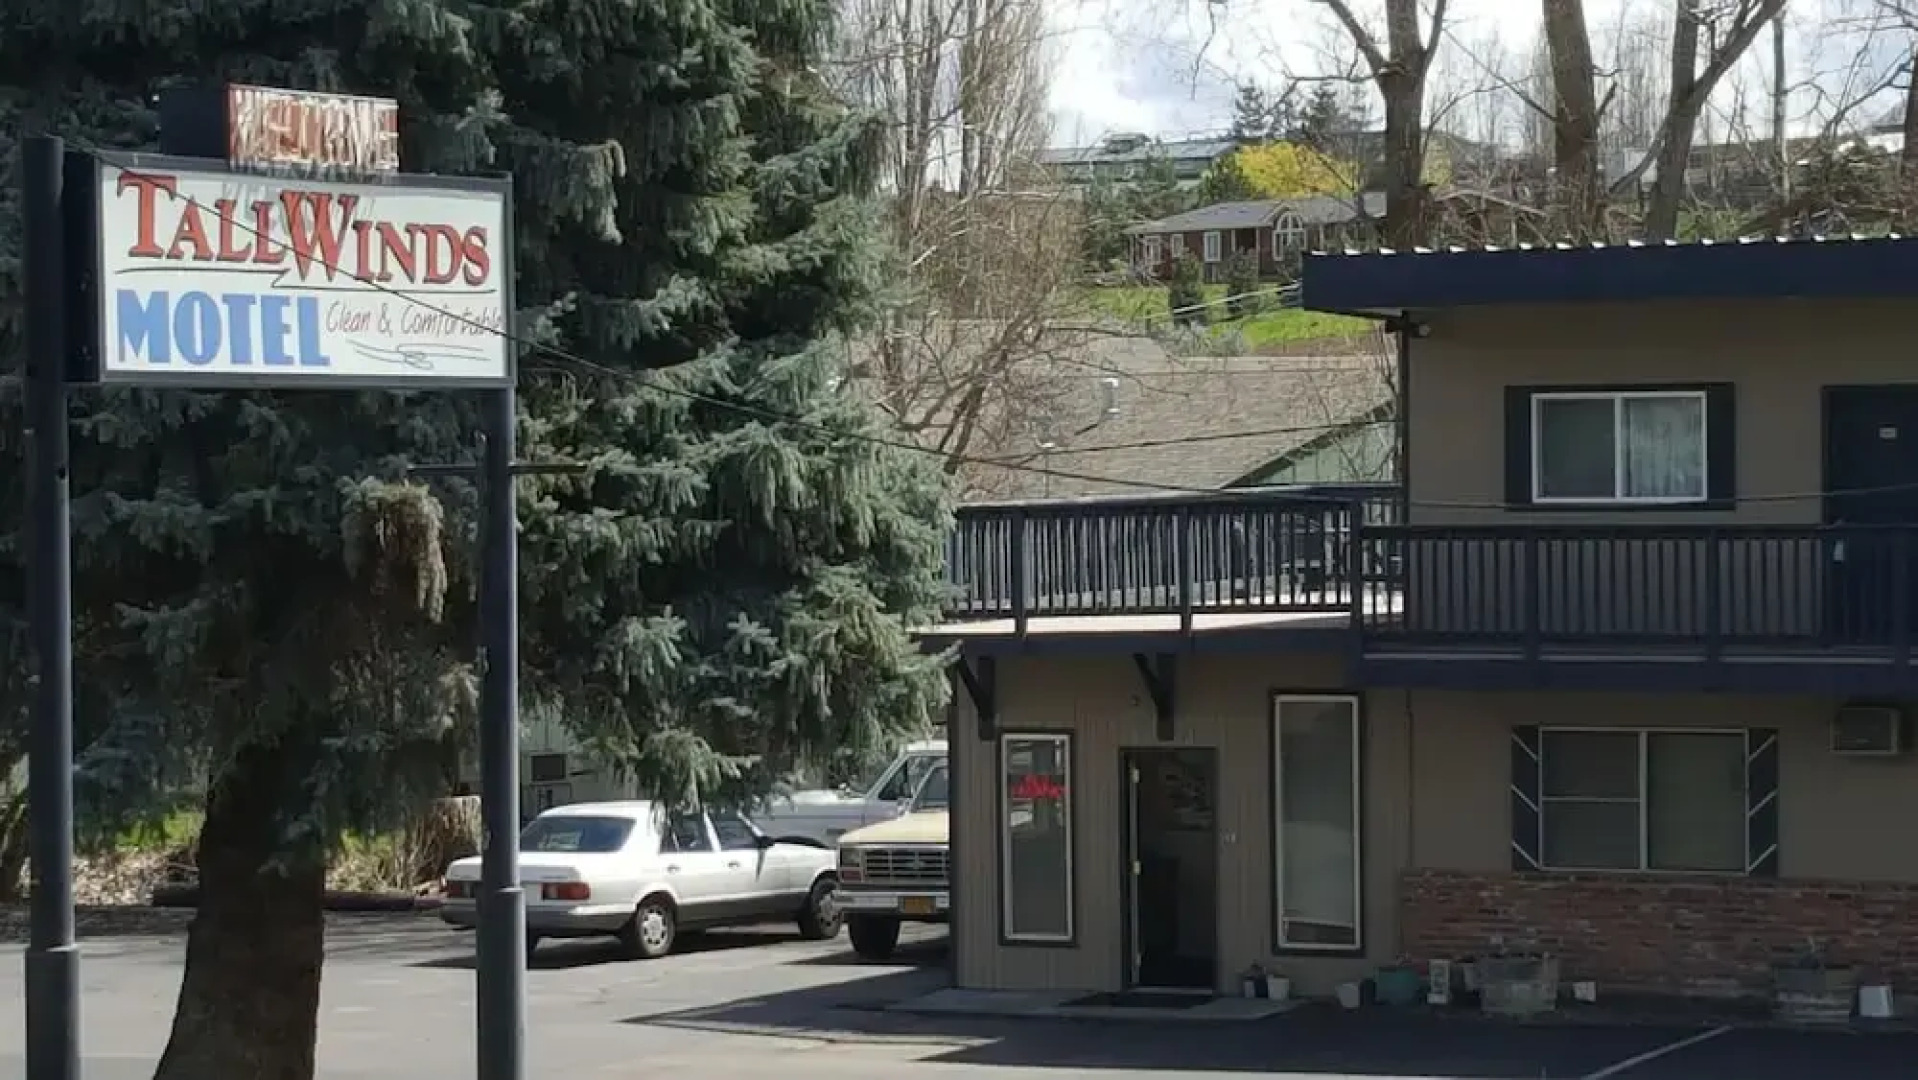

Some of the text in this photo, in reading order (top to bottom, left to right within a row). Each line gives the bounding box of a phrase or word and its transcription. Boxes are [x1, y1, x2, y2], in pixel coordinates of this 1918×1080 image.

[116, 290, 330, 366] MOTEL
[326, 300, 501, 337] Clean & Comfortable
